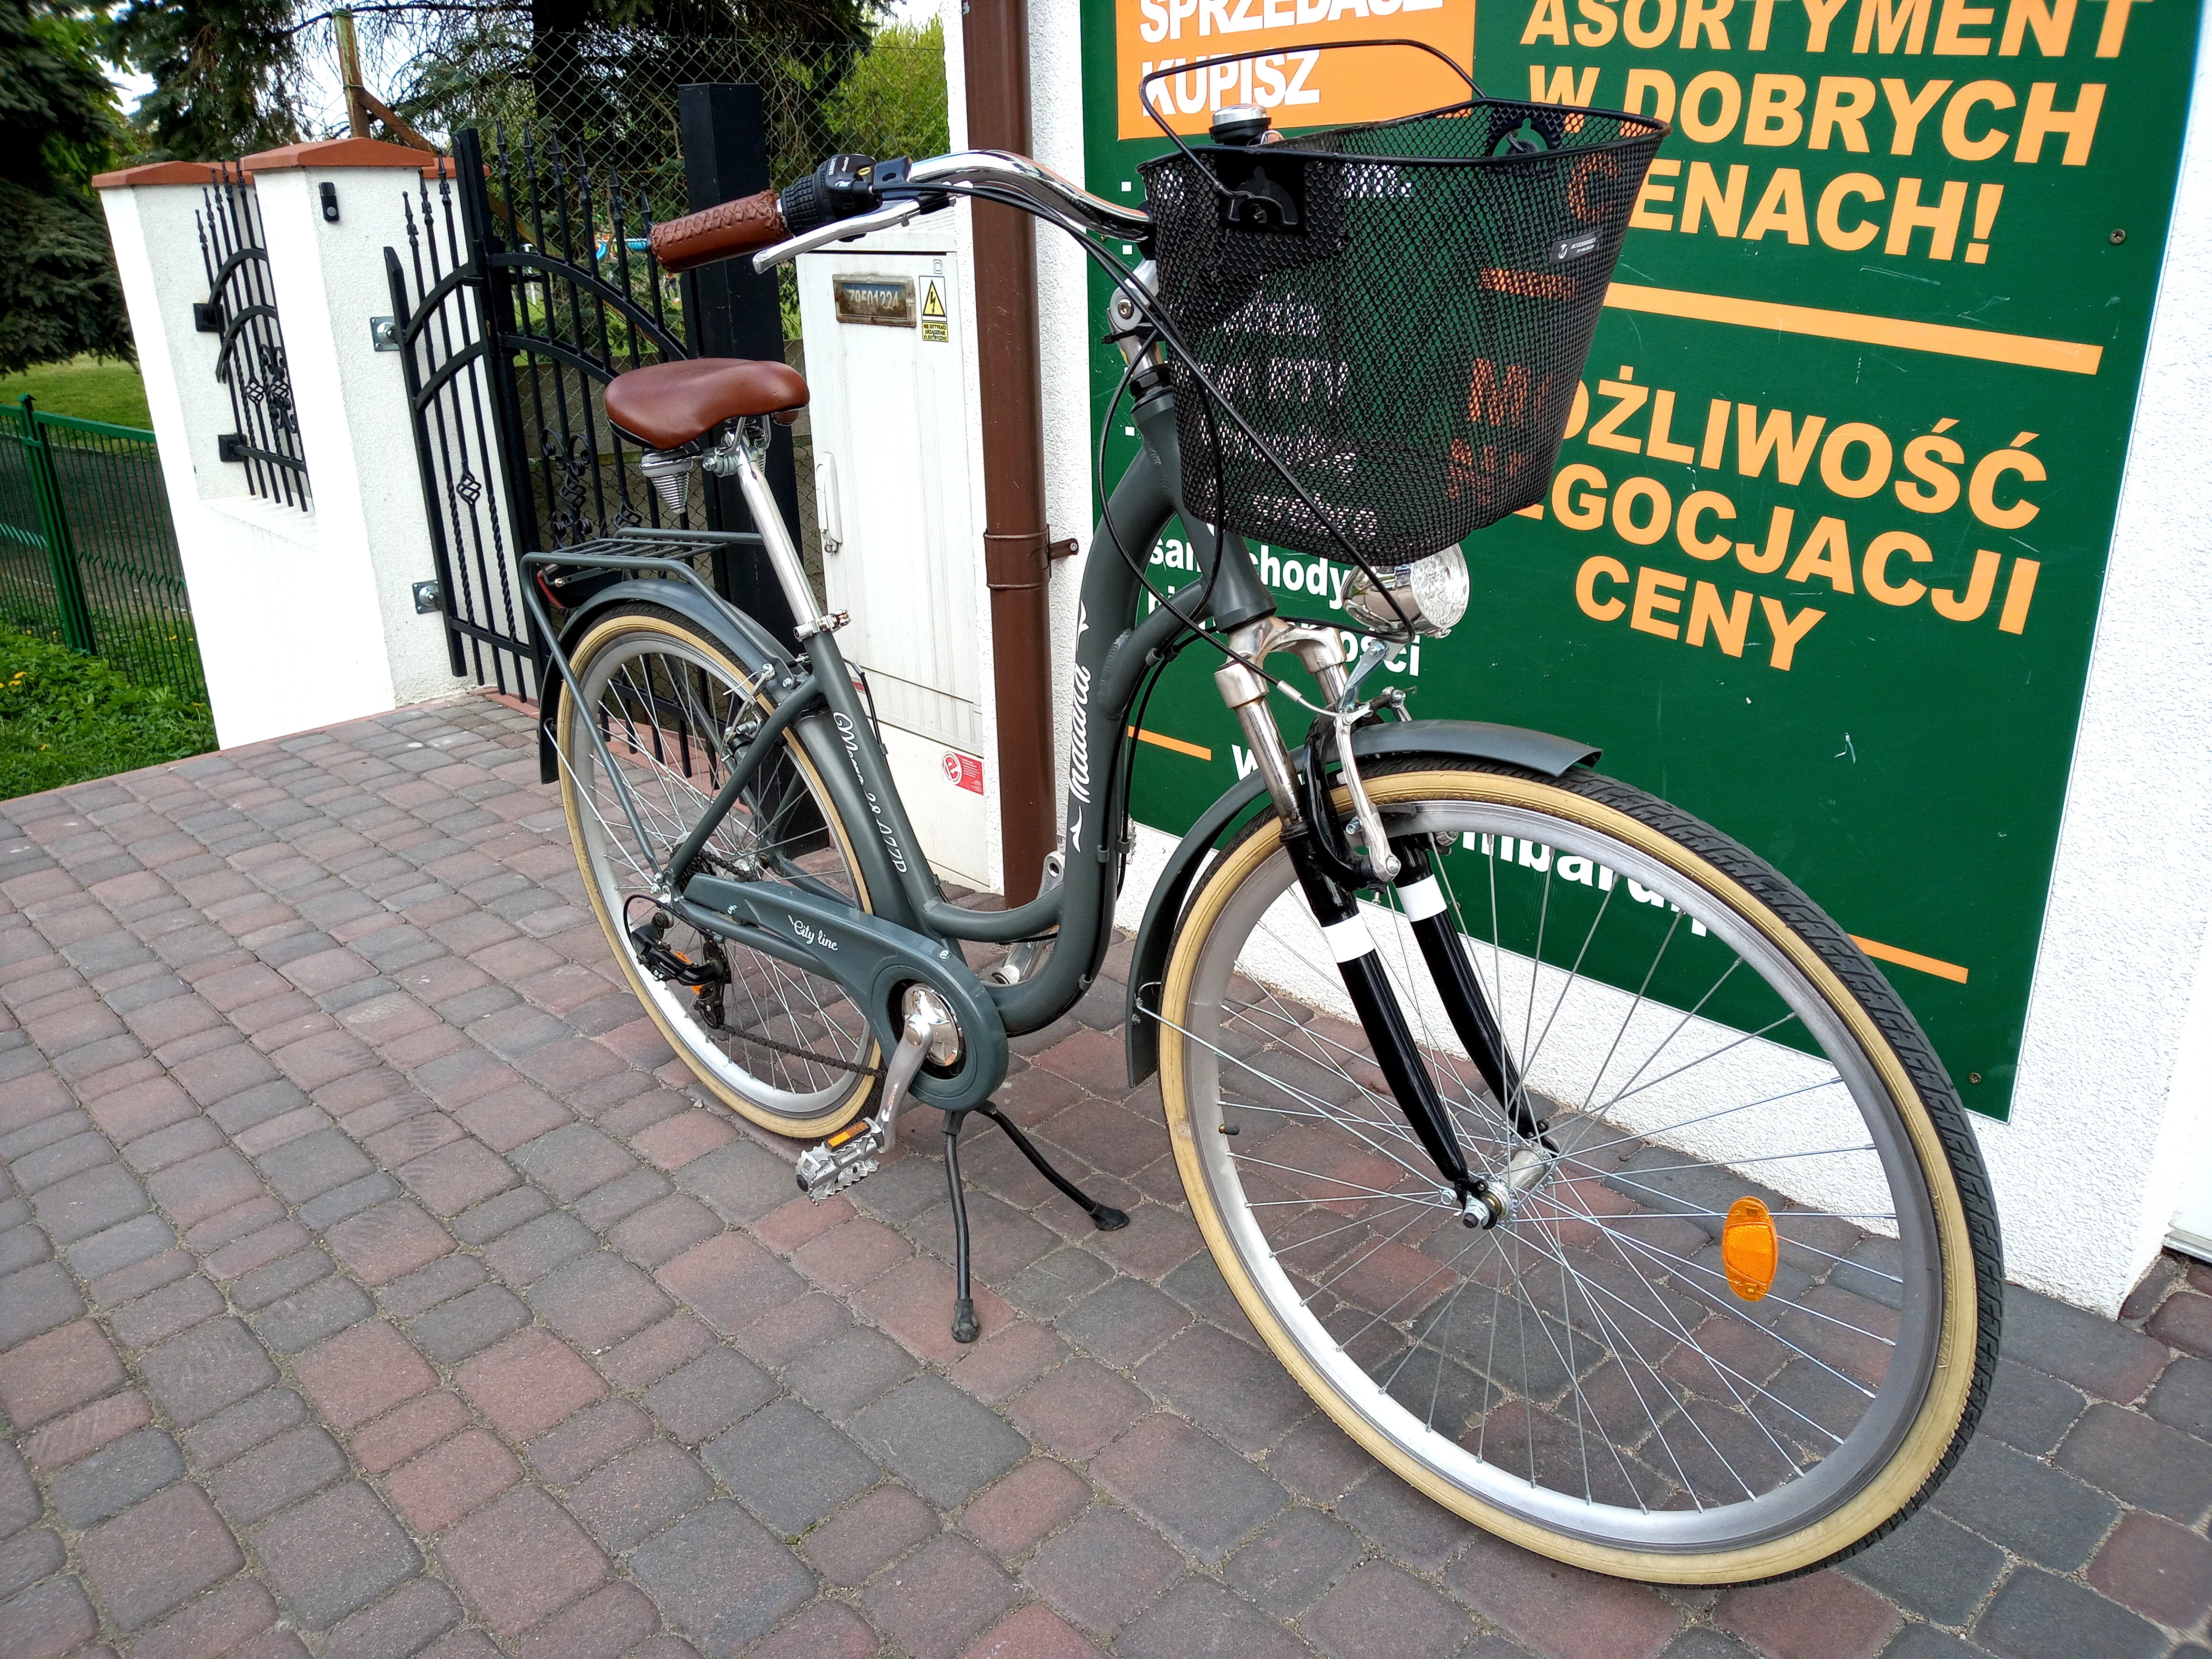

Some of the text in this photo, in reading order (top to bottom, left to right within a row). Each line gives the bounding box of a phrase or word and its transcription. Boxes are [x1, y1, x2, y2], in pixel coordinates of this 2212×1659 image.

[1521, 0, 2154, 58] ASORTYMENT
[1141, 49, 1321, 117] KUPISZ
[1529, 65, 2107, 166] W DOBRYCH
[1575, 555, 1826, 671] CENY
[793, 918, 839, 952] City line
